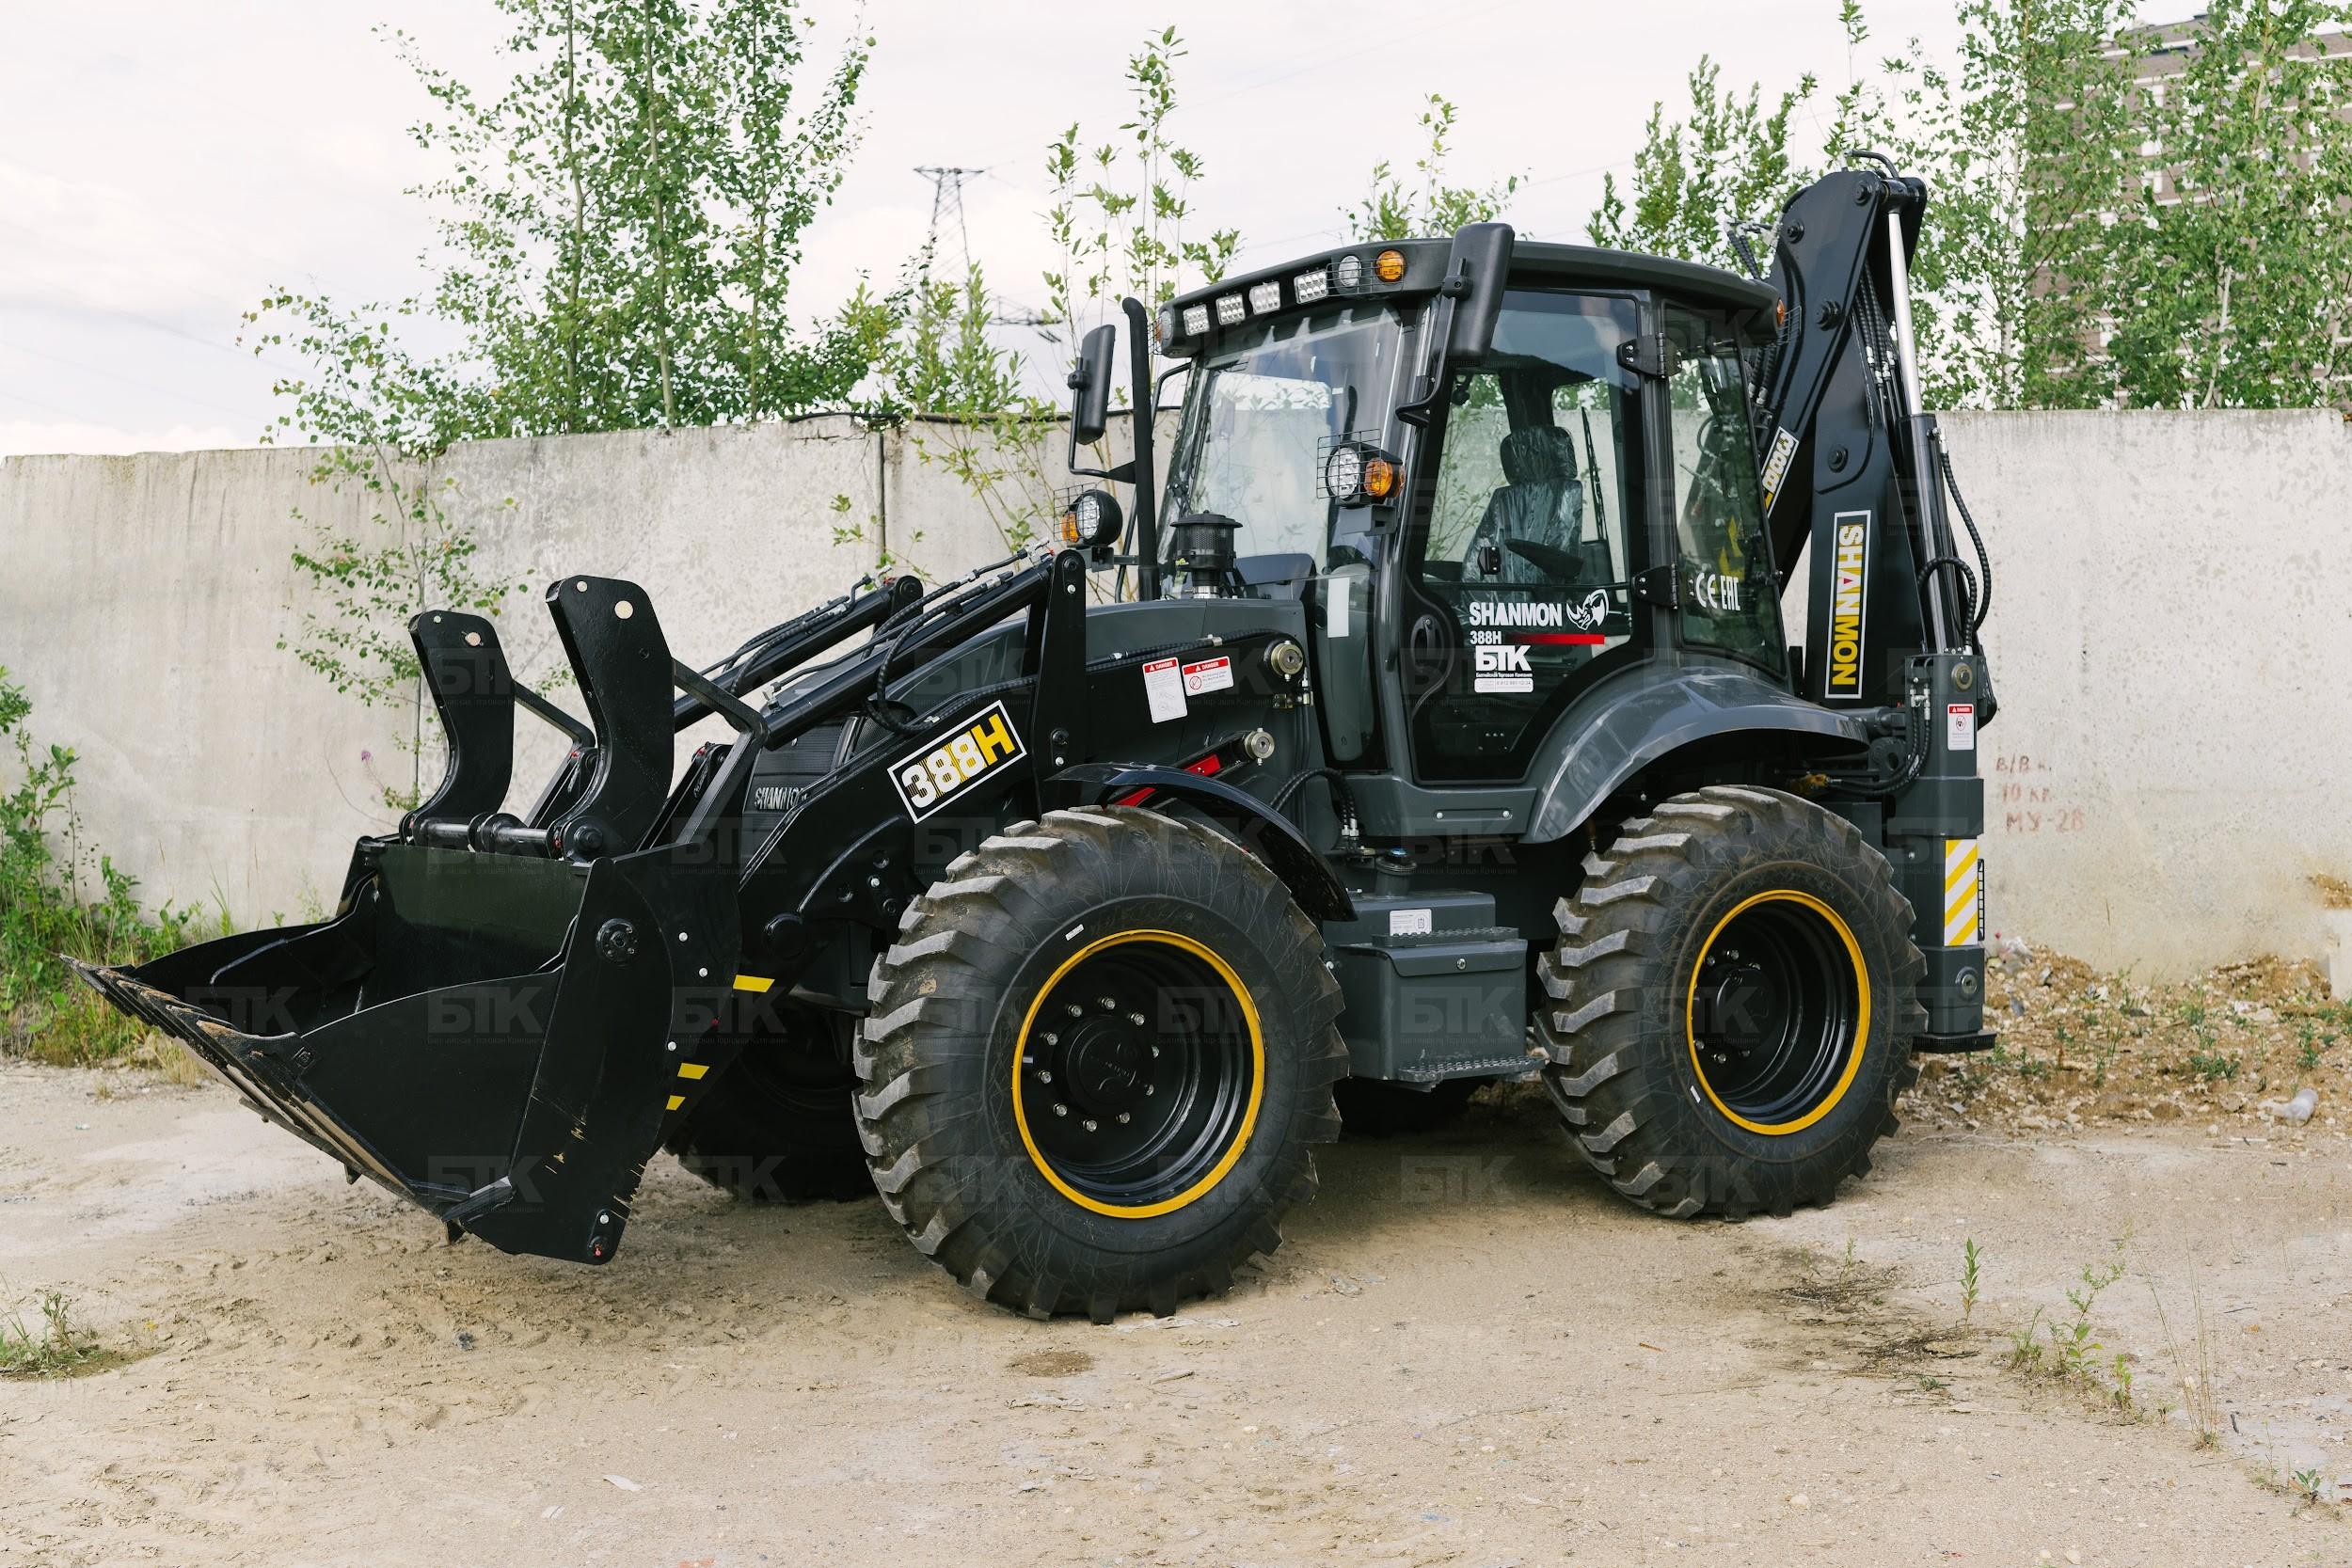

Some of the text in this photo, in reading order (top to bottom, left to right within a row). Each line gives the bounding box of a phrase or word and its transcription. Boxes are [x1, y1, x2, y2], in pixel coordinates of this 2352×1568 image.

[1761, 432, 1794, 510] 388
[1469, 602, 1563, 626] SHANMON
[1832, 524, 1865, 686] SHANMON
[1470, 630, 1502, 644] 388H
[1155, 661, 1173, 670] DANGER
[1201, 661, 1219, 671] DANGER
[1475, 645, 1533, 672] БТК
[901, 713, 1016, 808] 388H
